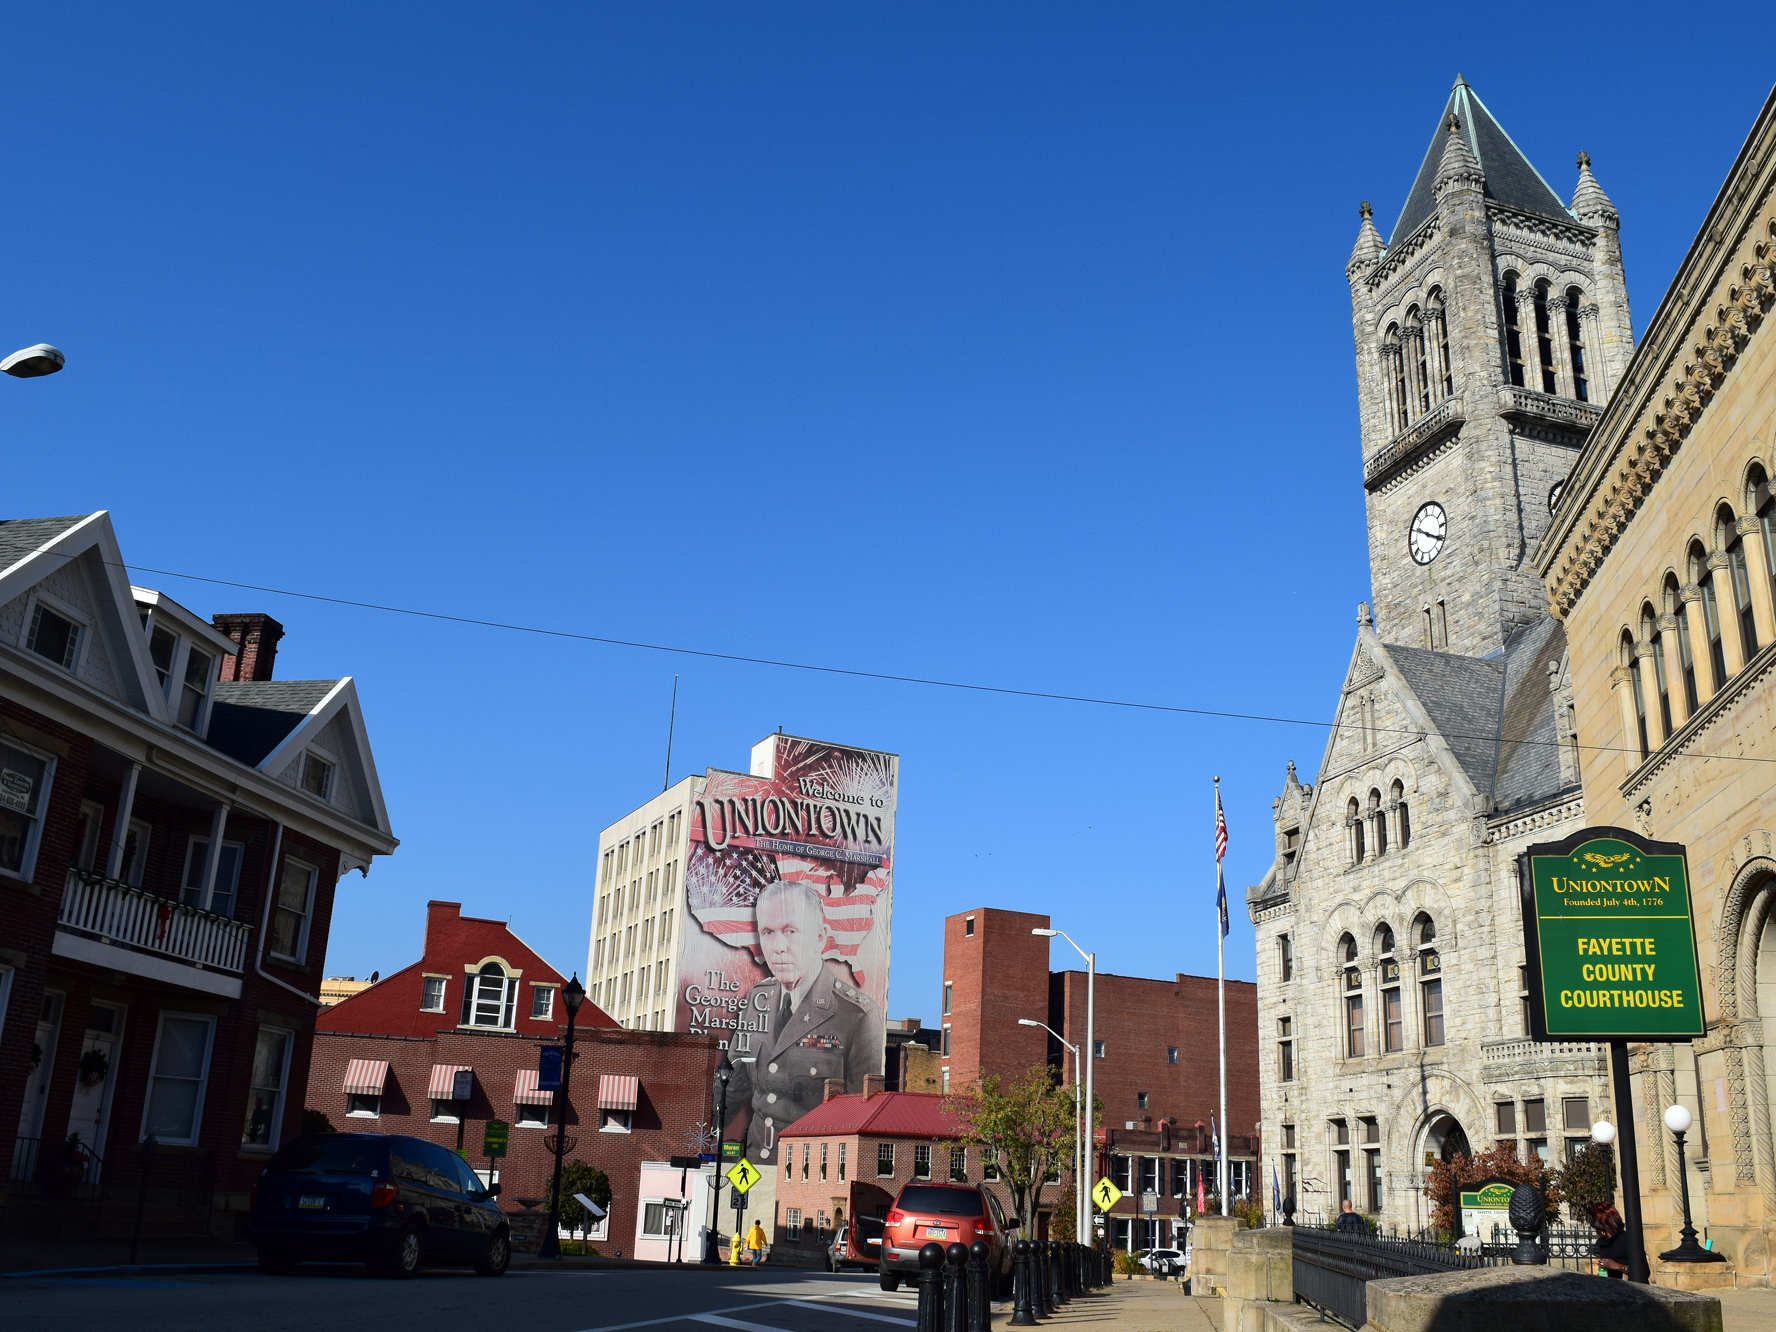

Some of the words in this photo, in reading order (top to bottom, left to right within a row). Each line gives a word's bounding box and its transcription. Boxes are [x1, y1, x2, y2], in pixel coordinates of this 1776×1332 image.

[798, 778, 865, 806] Welcome
[870, 795, 884, 808] to
[697, 795, 883, 850] UNIONTOWN
[1551, 876, 1670, 893] UNIONTOWN
[1563, 897, 1601, 906] Founded
[1602, 897, 1620, 907] July
[1622, 897, 1640, 907] 4th,
[1642, 897, 1663, 906] 1776
[1577, 938, 1656, 955] FAYETTE
[706, 969, 740, 991] The
[1582, 964, 1656, 981] COUNTY
[685, 984, 748, 1012] George
[754, 991, 771, 1012] C.
[1560, 990, 1684, 1008] COURTHOUSE
[690, 1006, 769, 1033] Marshall
[1477, 1195, 1510, 1203] UNIONTO
